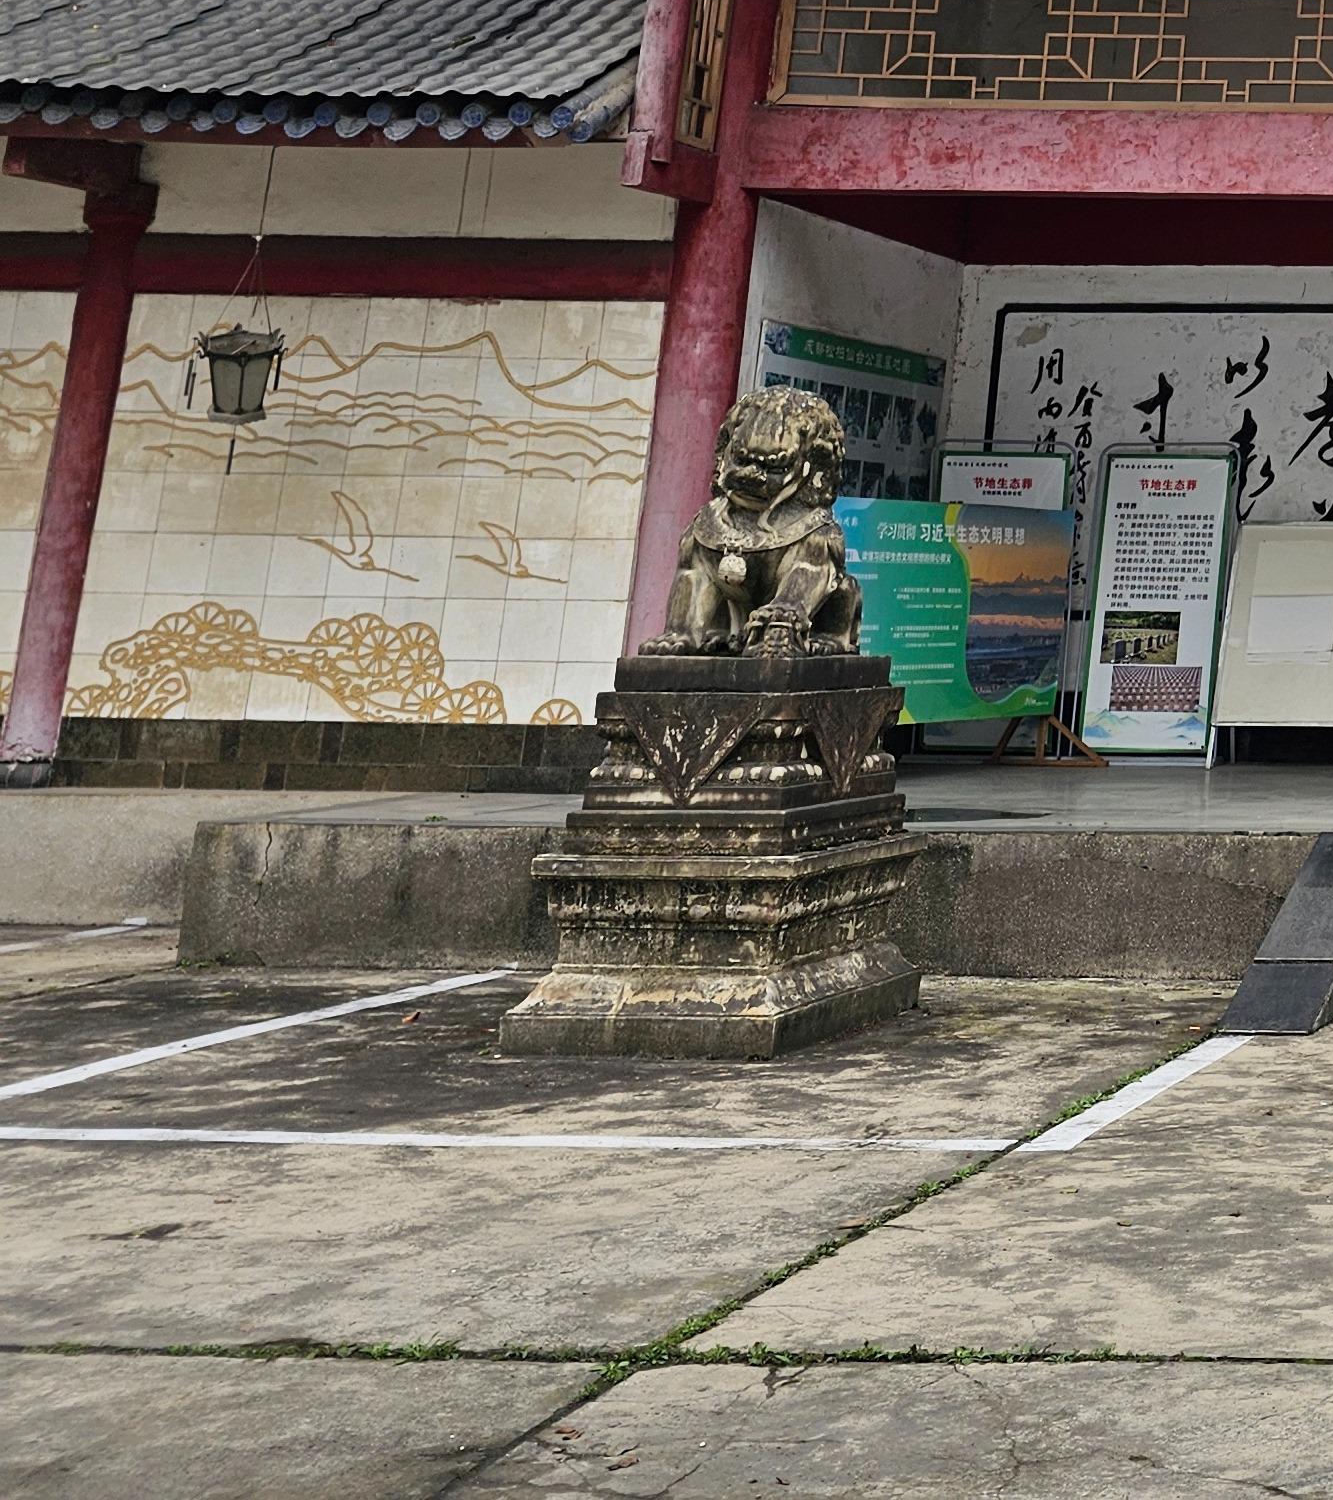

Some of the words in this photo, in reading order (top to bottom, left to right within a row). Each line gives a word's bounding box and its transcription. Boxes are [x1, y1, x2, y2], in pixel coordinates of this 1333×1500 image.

[973, 476, 1033, 490] 节地生态葬
[1139, 479, 1198, 491] 节地生态葬
[919, 523, 1026, 546] 习近平生态文明思想
